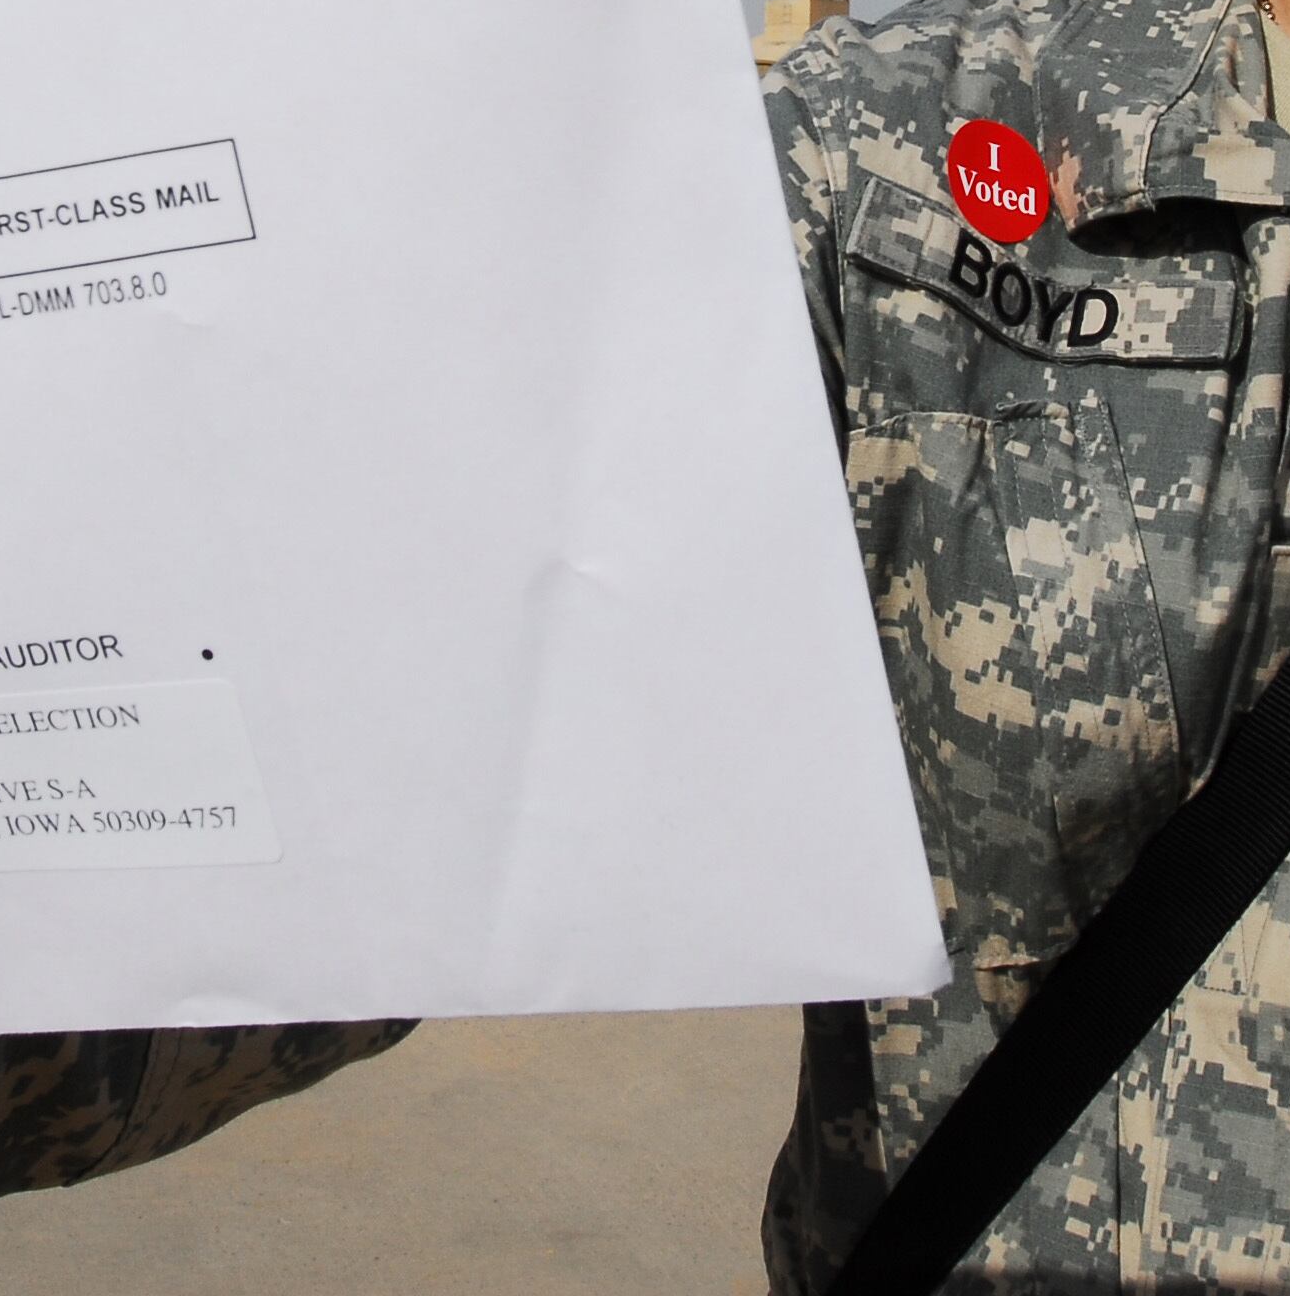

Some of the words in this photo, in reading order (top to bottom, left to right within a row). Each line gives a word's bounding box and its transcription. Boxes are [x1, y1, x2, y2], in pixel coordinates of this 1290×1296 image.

[988, 142, 1002, 173] I
[155, 180, 220, 210] MAIL
[956, 164, 1037, 216] Voted
[83, 271, 167, 306] 703.8.0
[948, 229, 1120, 347] BOYD
[47, 777, 97, 801] S-A
[5, 811, 87, 838] IOWA
[92, 805, 237, 835] 50309-4757
